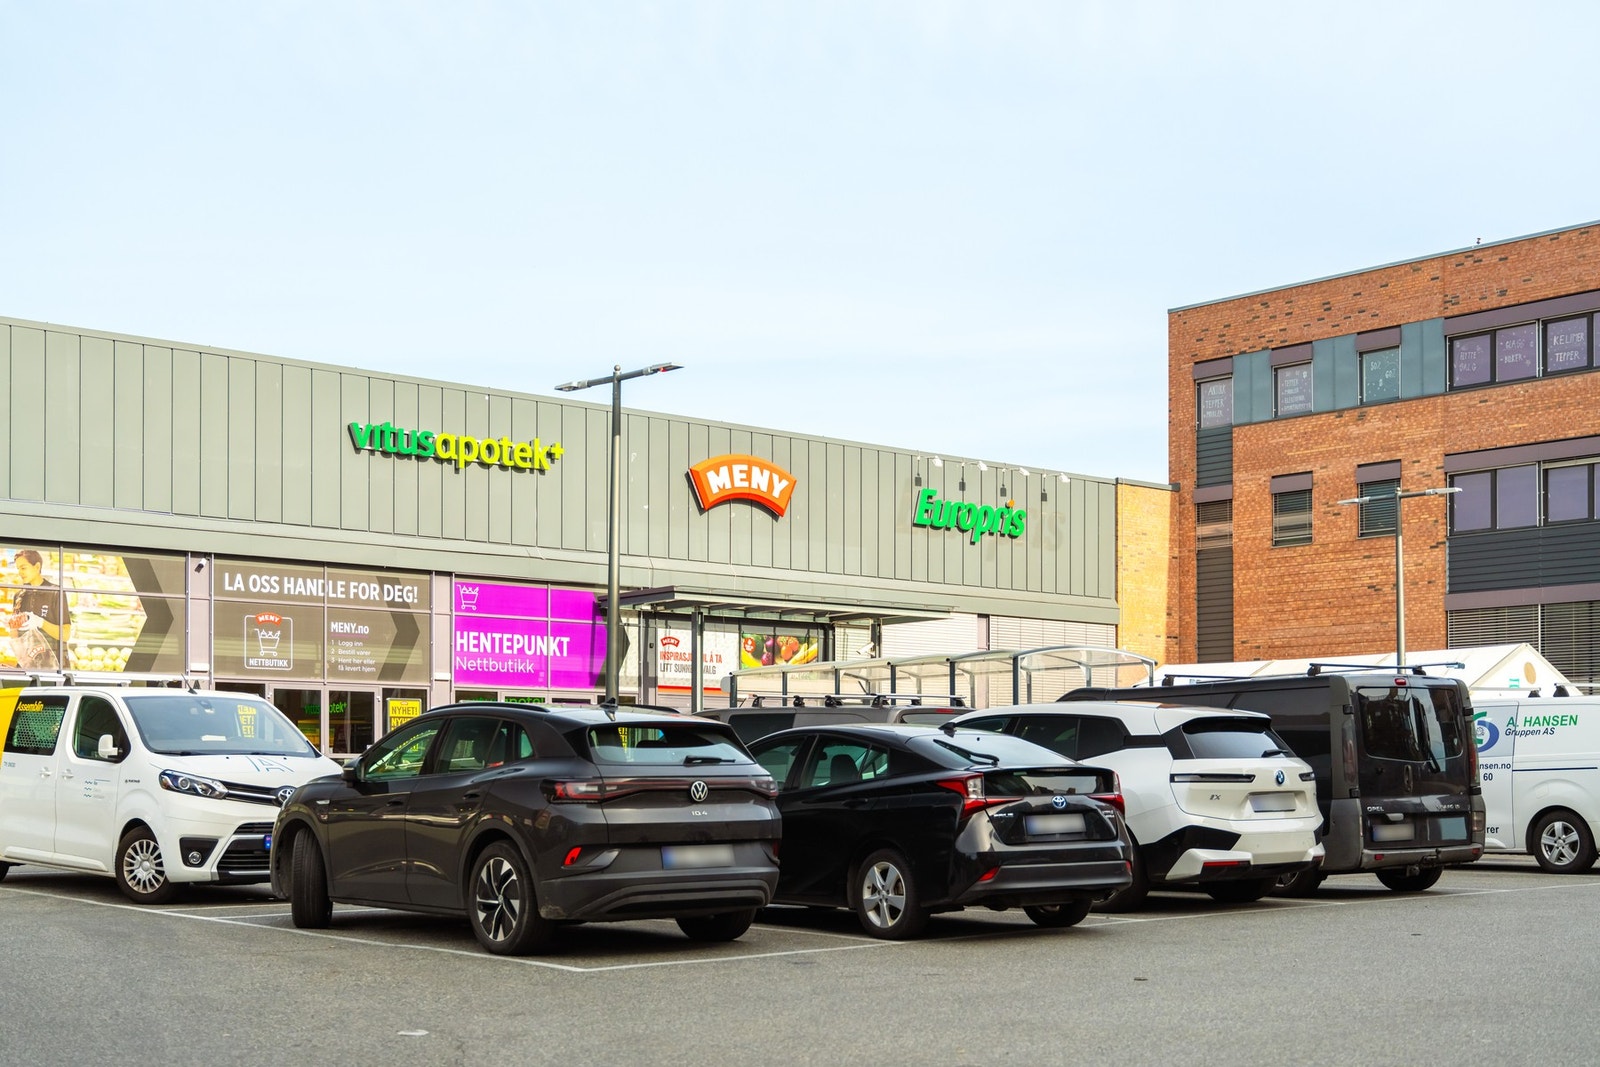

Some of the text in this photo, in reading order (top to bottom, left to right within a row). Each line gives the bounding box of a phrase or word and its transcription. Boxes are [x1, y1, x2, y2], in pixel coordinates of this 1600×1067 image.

[705, 464, 790, 499] MENY
[913, 488, 1027, 543] Europris
[224, 572, 418, 603] LA OSS HANDLE FOR DEG!
[257, 614, 281, 624] MENY
[331, 621, 370, 635] MENY.no
[338, 640, 354, 648] Logg
[455, 630, 571, 657] HENTEPUNKT
[338, 648, 356, 656] Bestill
[709, 651, 714, 663] Å
[715, 653, 723, 664] TA
[249, 657, 289, 668] NETTBUTIKK
[456, 656, 535, 673] Nettbutikk
[16, 701, 44, 712] Assemblin
[391, 706, 418, 716] NYHET!
[1506, 714, 1578, 728] A. HANSEN
[1504, 727, 1555, 737] Gruppen AS
[1479, 762, 1511, 770] nsen.no
[1483, 773, 1493, 781] 60
